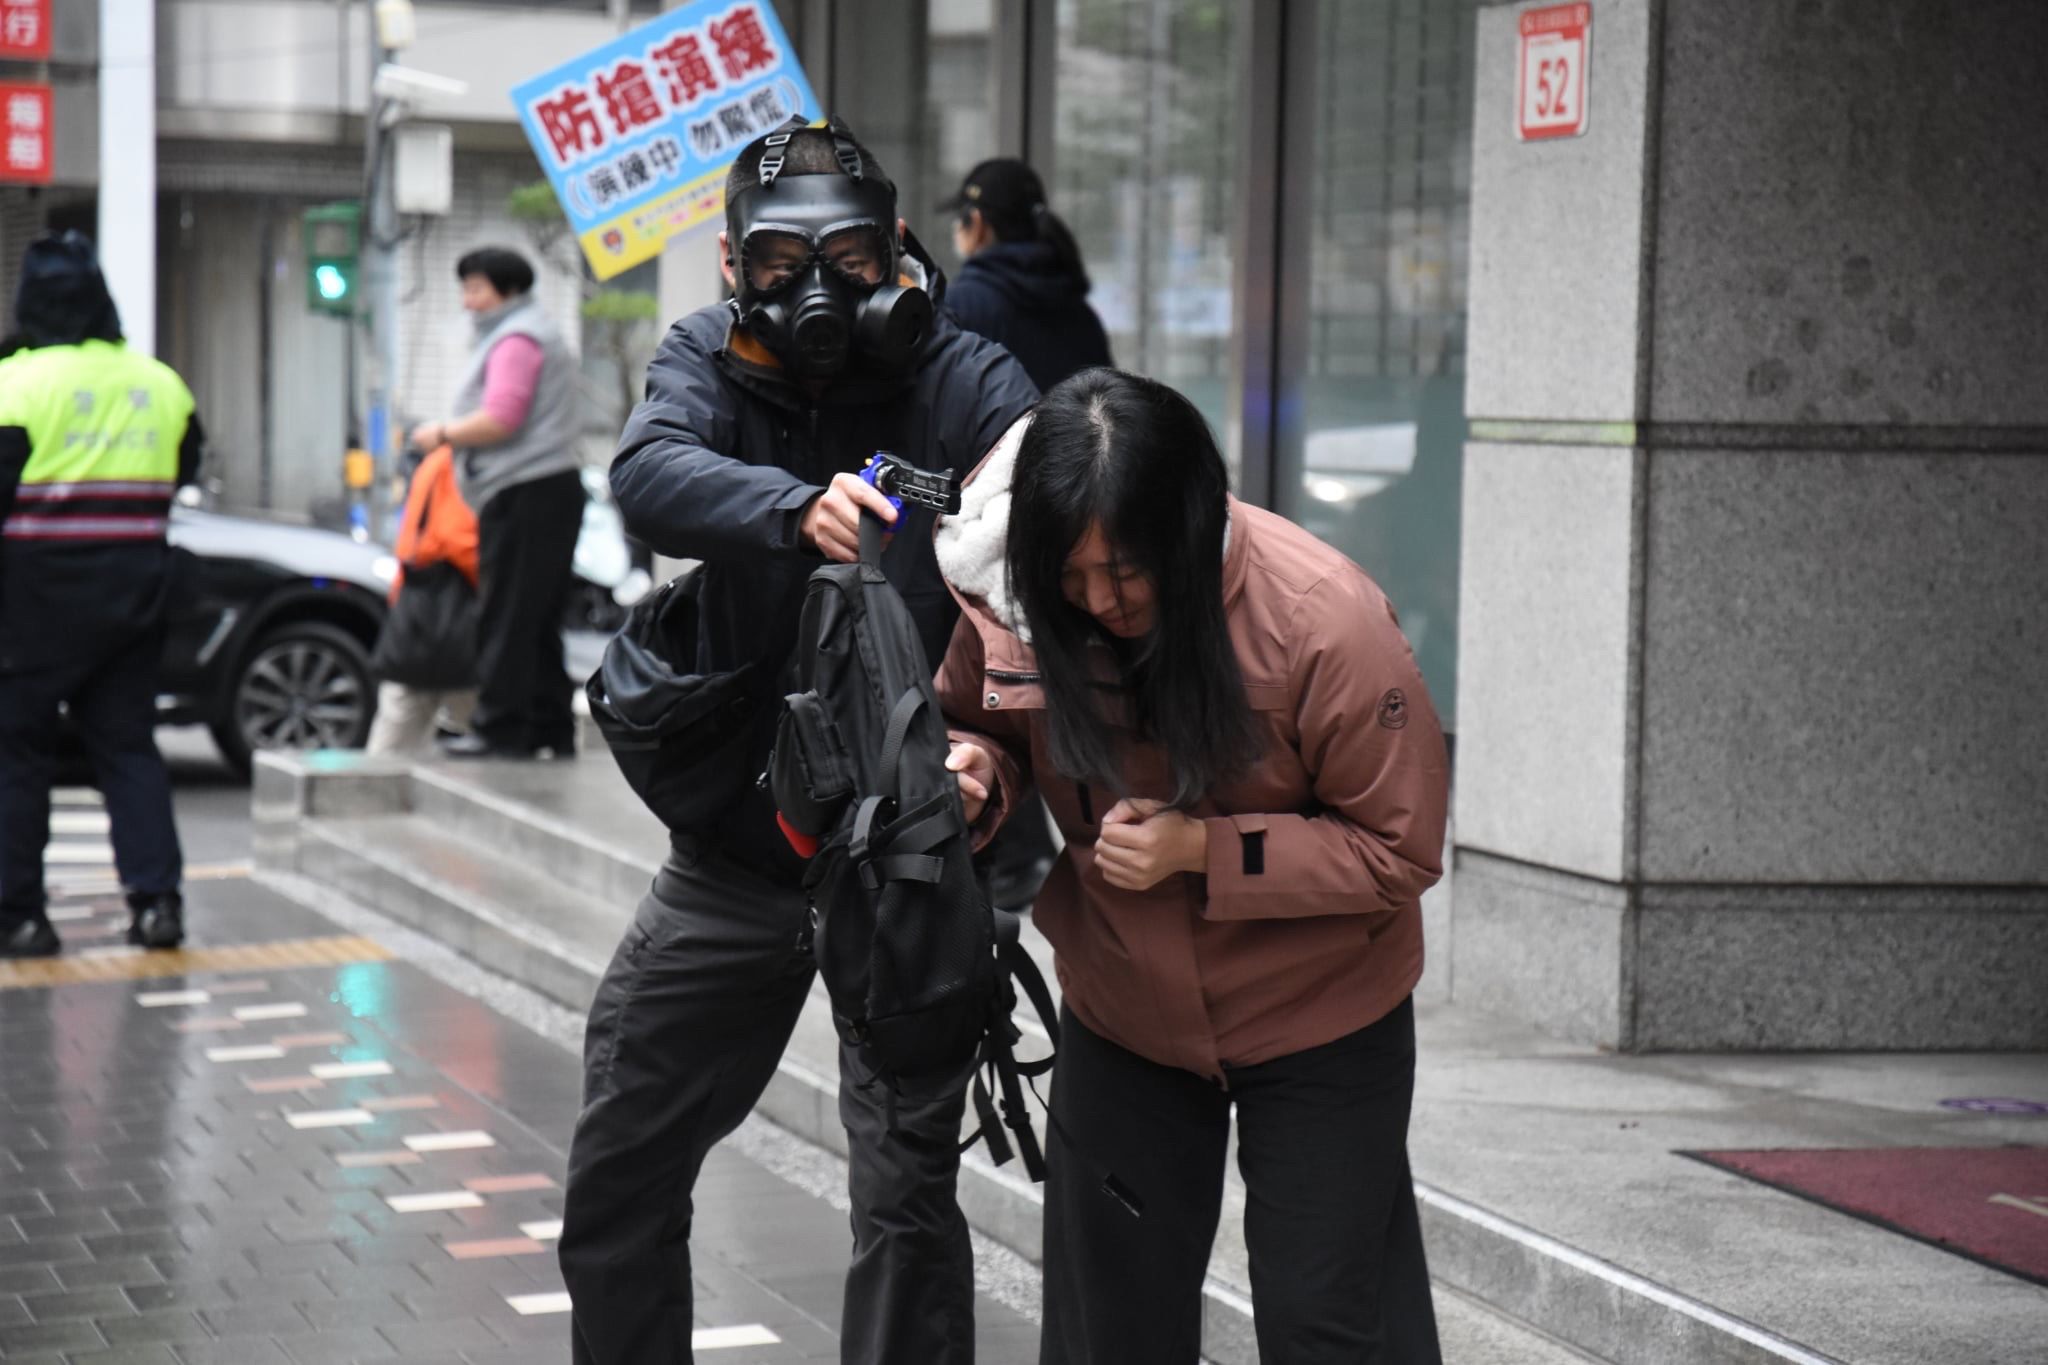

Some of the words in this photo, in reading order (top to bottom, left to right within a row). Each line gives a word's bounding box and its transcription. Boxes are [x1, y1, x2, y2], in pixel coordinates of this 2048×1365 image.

[3, 0, 38, 46] 行
[535, 6, 777, 163] 防搶演練
[1537, 57, 1568, 117] 52
